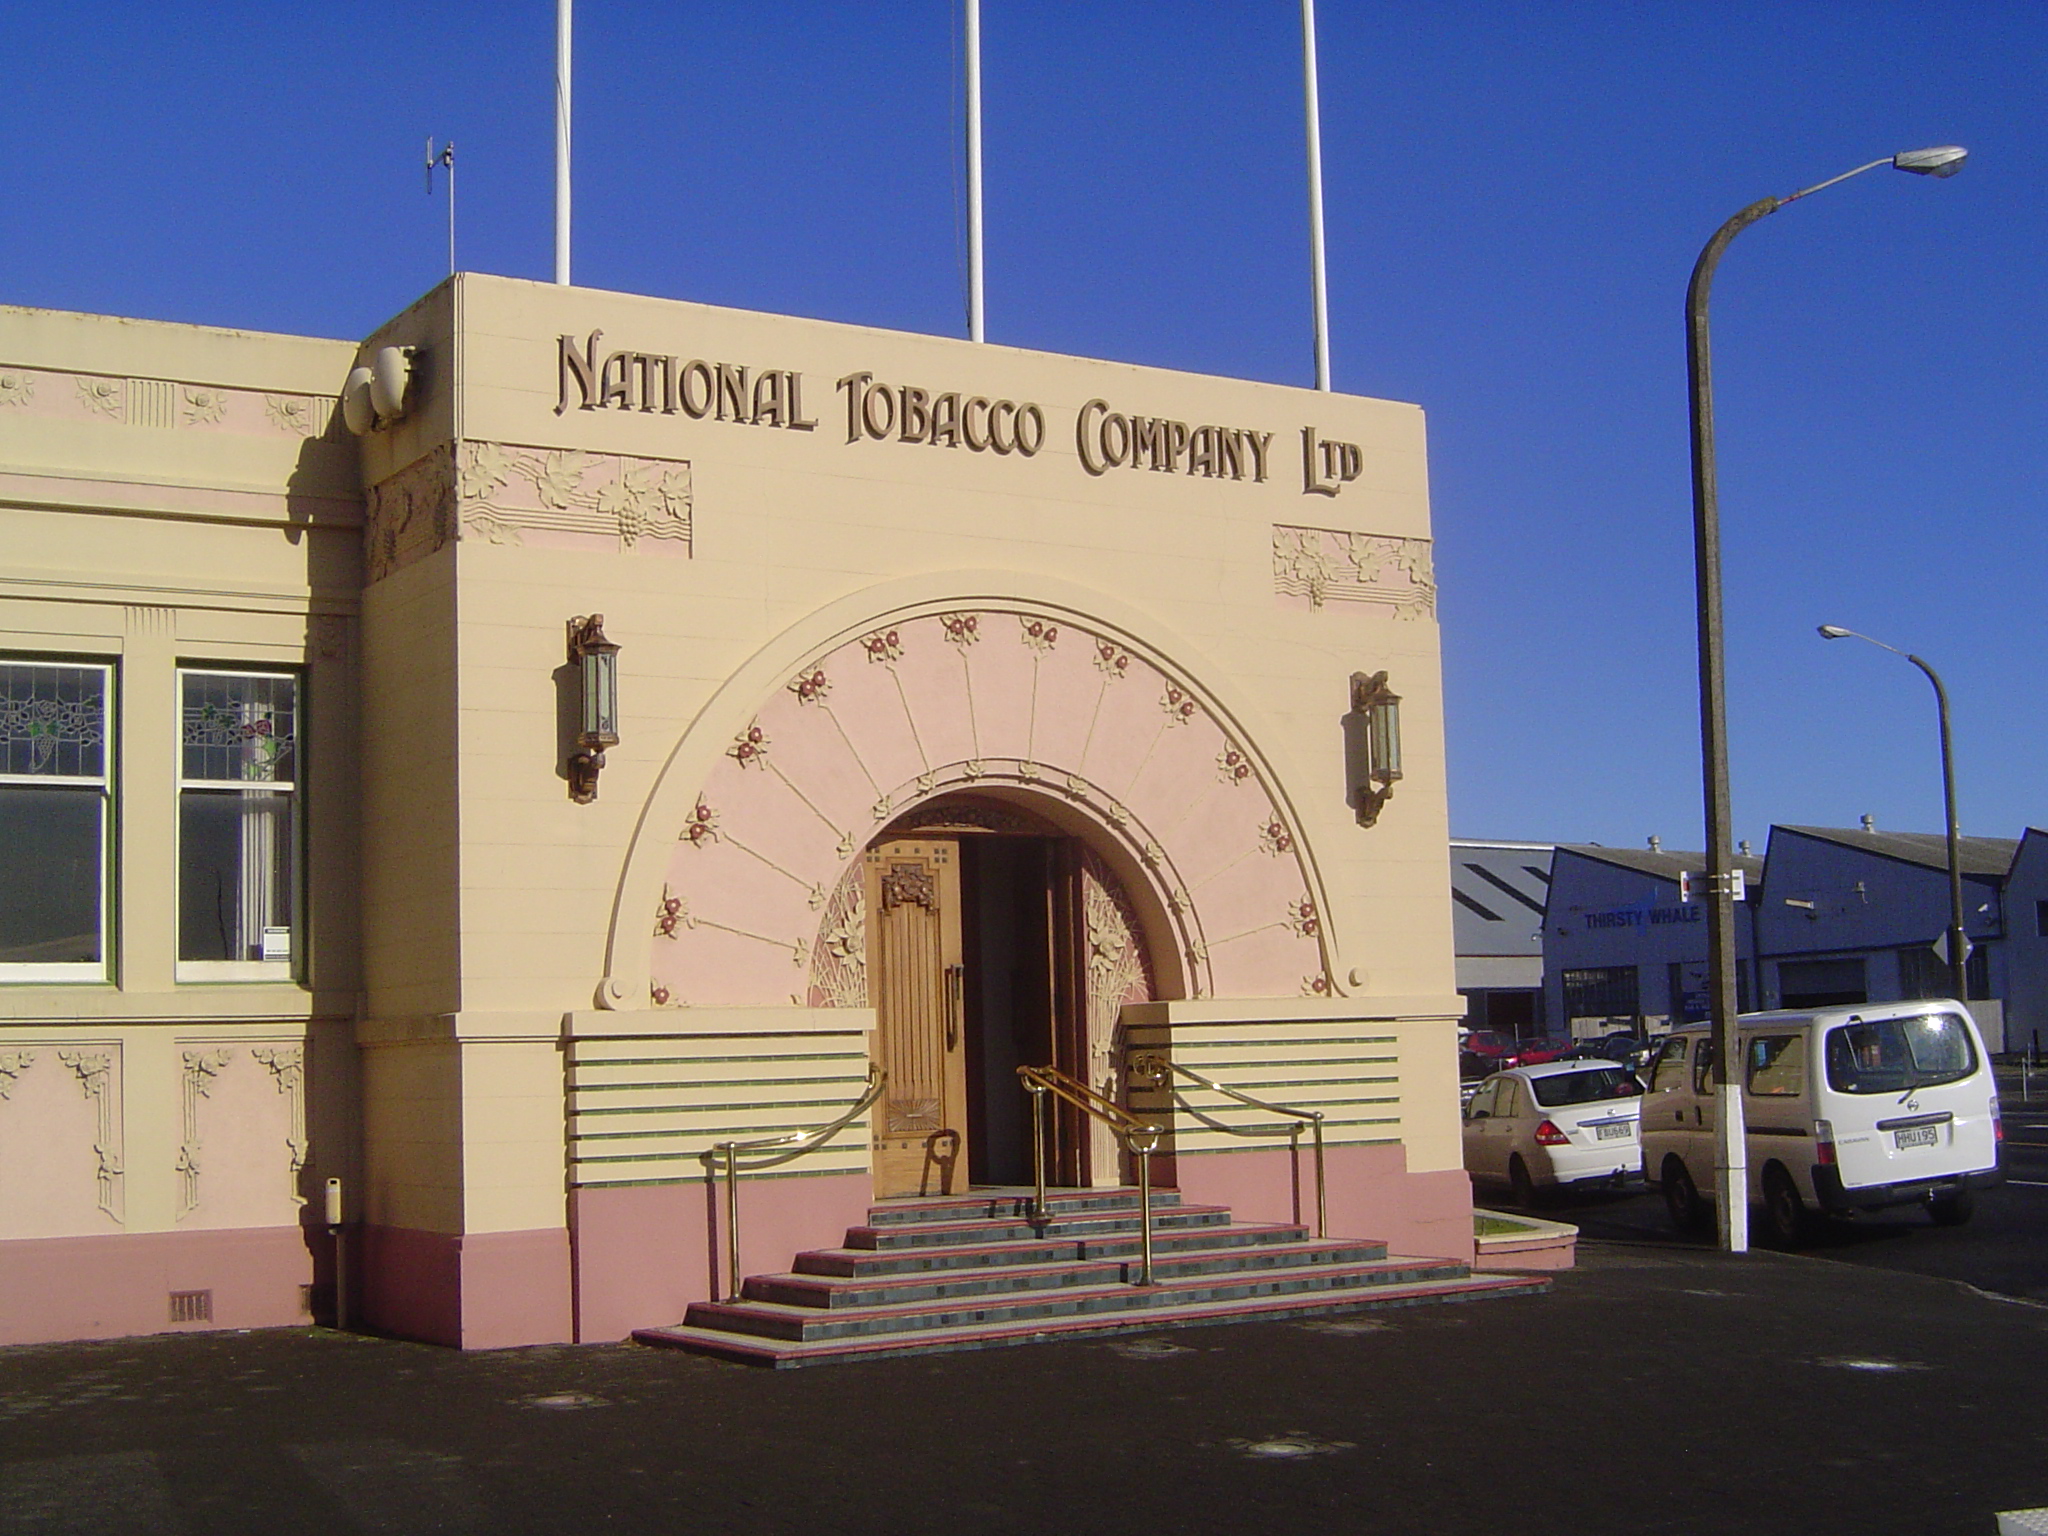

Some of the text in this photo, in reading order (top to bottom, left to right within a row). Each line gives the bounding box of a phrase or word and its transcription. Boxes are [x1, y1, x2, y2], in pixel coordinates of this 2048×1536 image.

[553, 328, 1364, 498] NATIONAL TOBACCO COMPANY LTD
[1585, 906, 1700, 928] THIRSTY WHALE
[1897, 1130, 1935, 1143] HHU195
